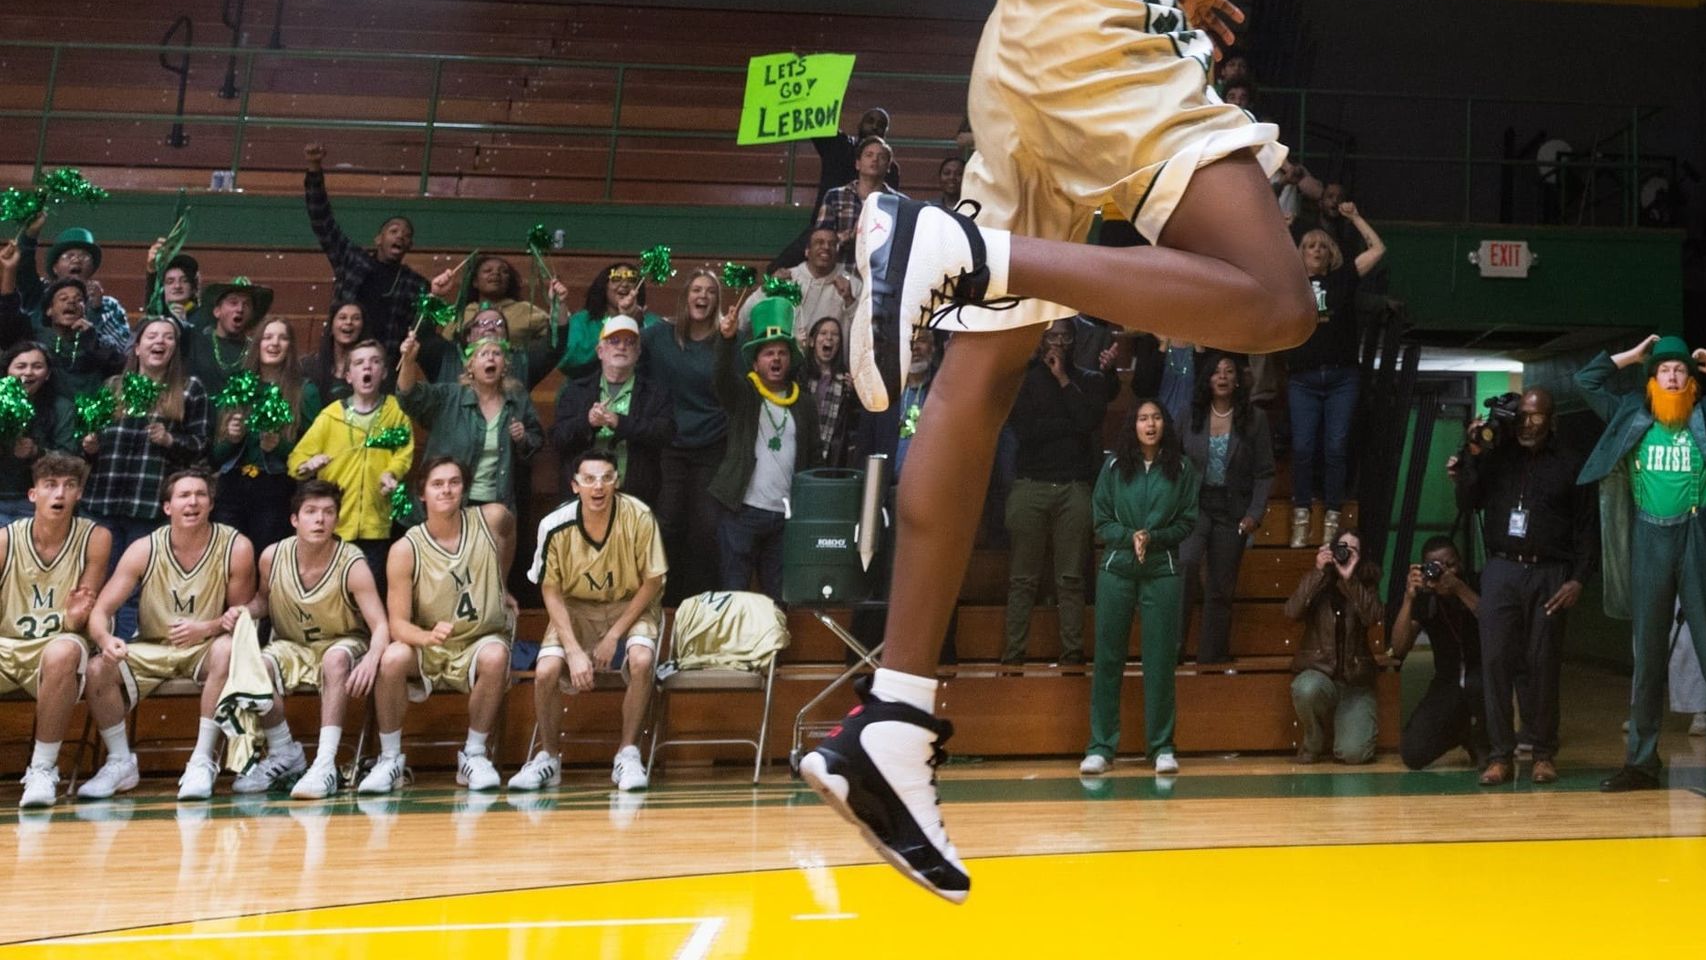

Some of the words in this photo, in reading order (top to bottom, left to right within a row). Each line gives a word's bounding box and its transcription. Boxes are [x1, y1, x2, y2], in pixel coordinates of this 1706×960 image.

[763, 58, 807, 87] LETS
[779, 77, 818, 100] GO!
[757, 99, 840, 138] LEBRON
[1489, 242, 1522, 268] EXIT
[1646, 444, 1692, 472] IRISH
[456, 591, 479, 623] 4
